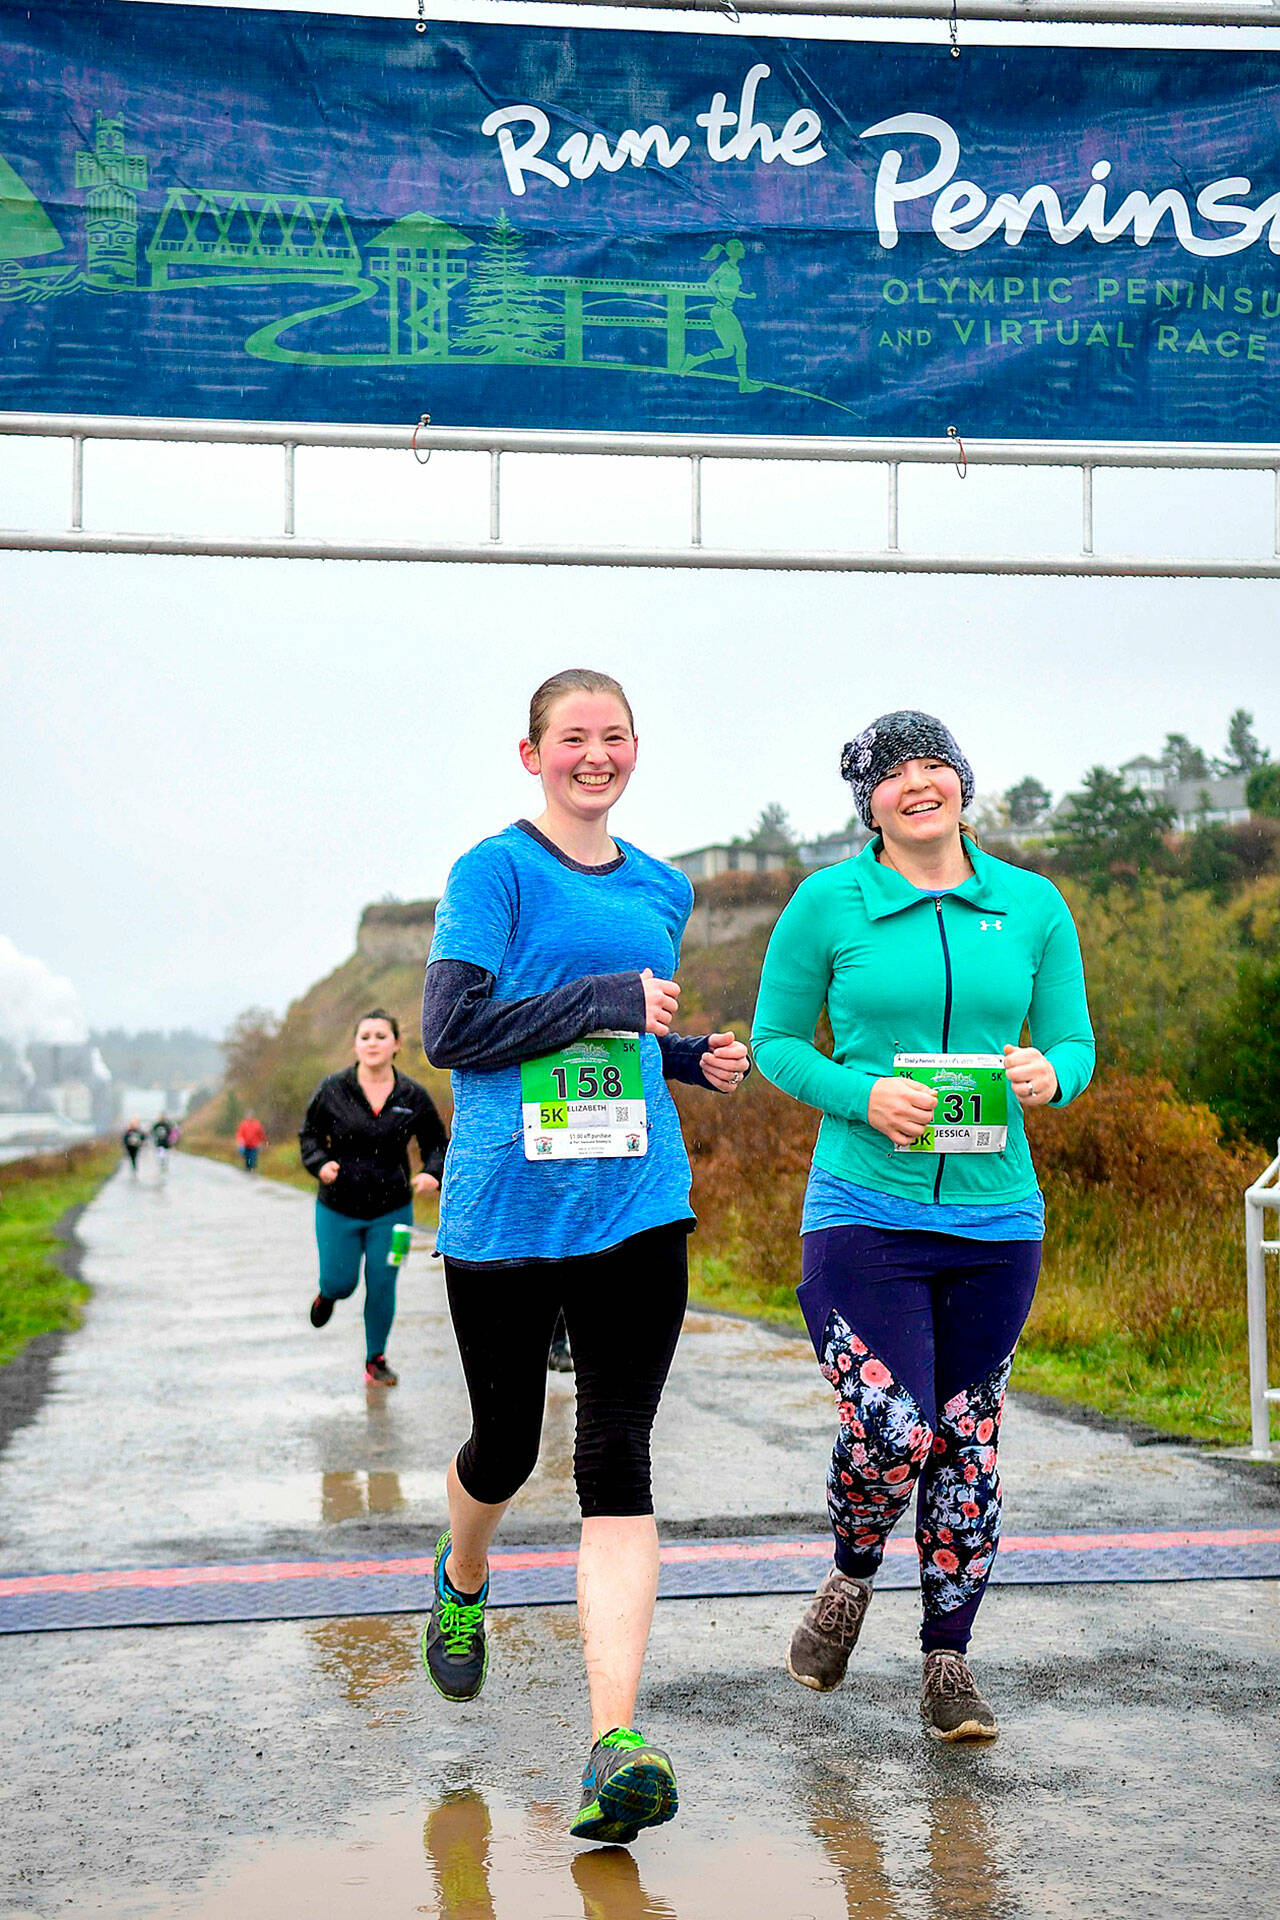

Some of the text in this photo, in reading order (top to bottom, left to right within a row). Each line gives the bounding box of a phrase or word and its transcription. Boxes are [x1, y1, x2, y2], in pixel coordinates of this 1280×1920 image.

[482, 63, 828, 196] Run the
[882, 277, 1073, 306] OLYMPIC
[878, 319, 1268, 362] AND VIRTUAL RACE
[623, 1042, 636, 1053] 5K
[550, 1065, 623, 1100] 158
[991, 1072, 1003, 1082] 5K
[540, 1107, 564, 1123] 5K
[566, 1104, 607, 1113] ELIZABETH
[930, 1093, 982, 1124] 31
[934, 1128, 971, 1138] JESSICA
